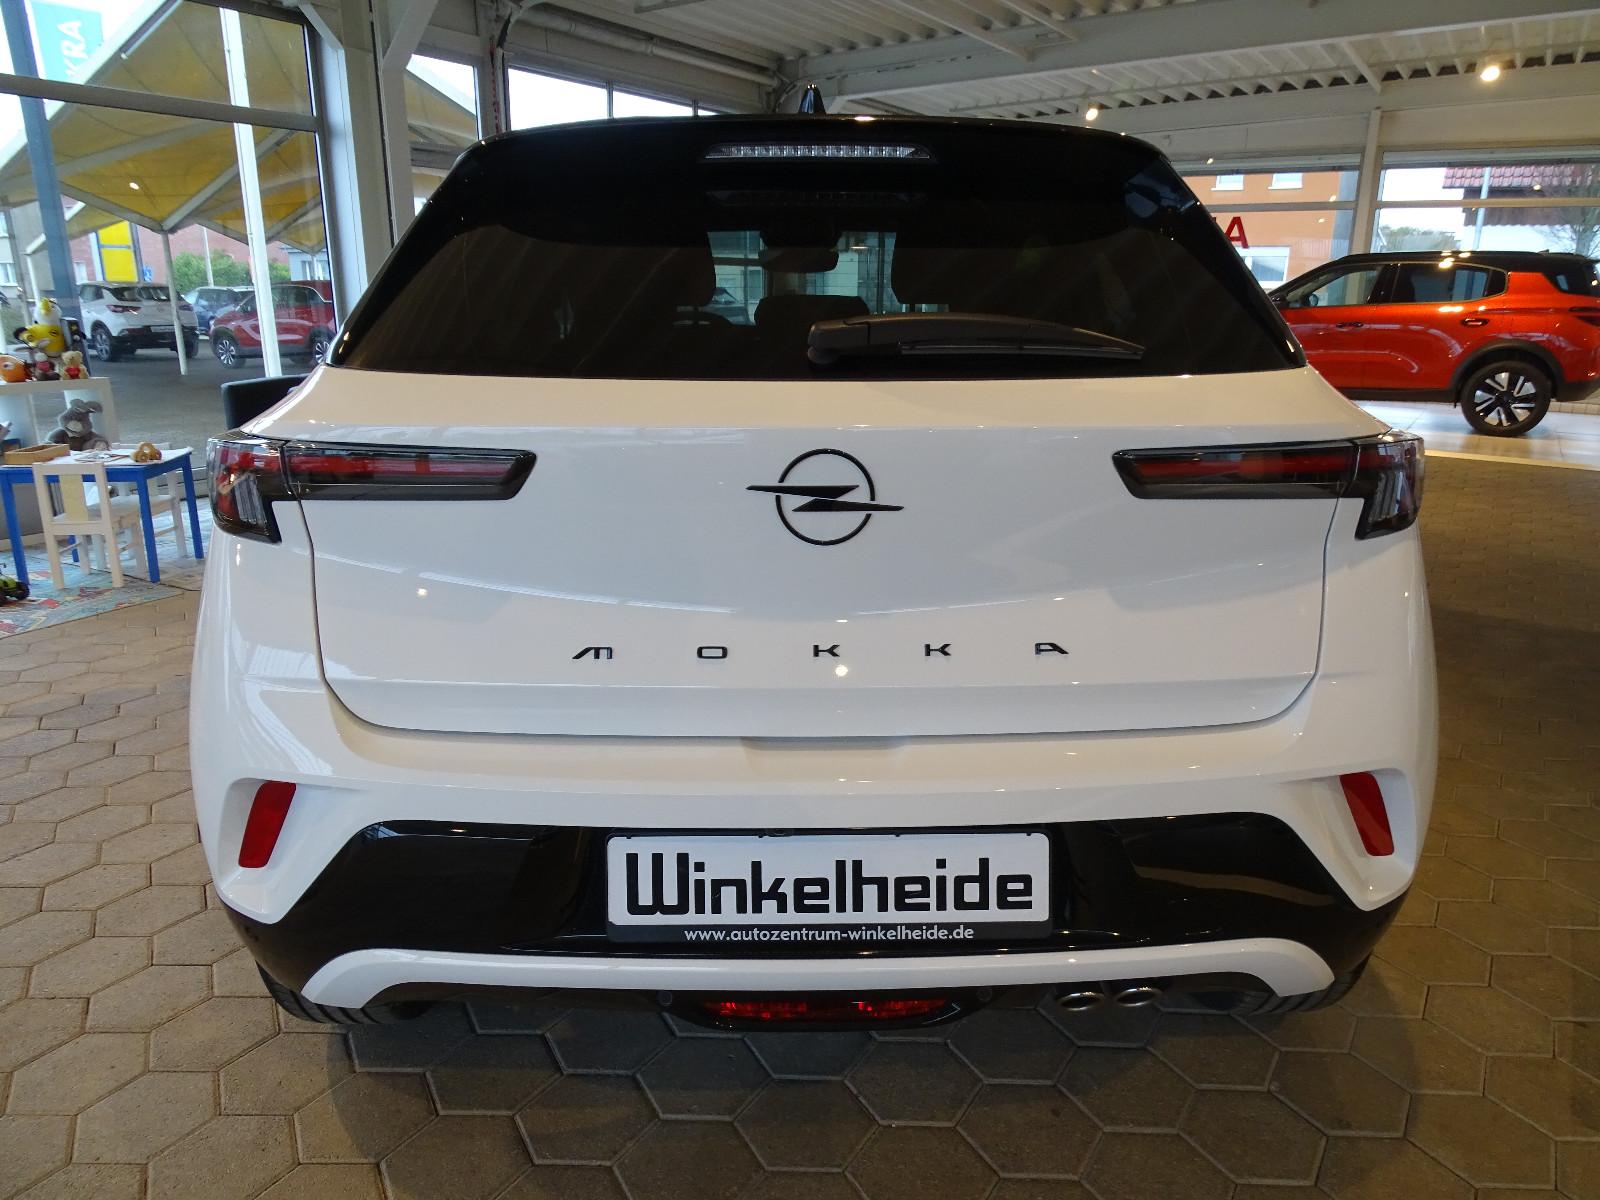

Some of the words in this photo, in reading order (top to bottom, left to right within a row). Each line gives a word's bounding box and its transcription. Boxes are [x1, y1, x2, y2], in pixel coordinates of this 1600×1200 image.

[572, 642, 1069, 660] MOKKA
[626, 852, 1033, 916] Winkelheide
[684, 924, 975, 942] www.autozentrum-winkelheide.de
